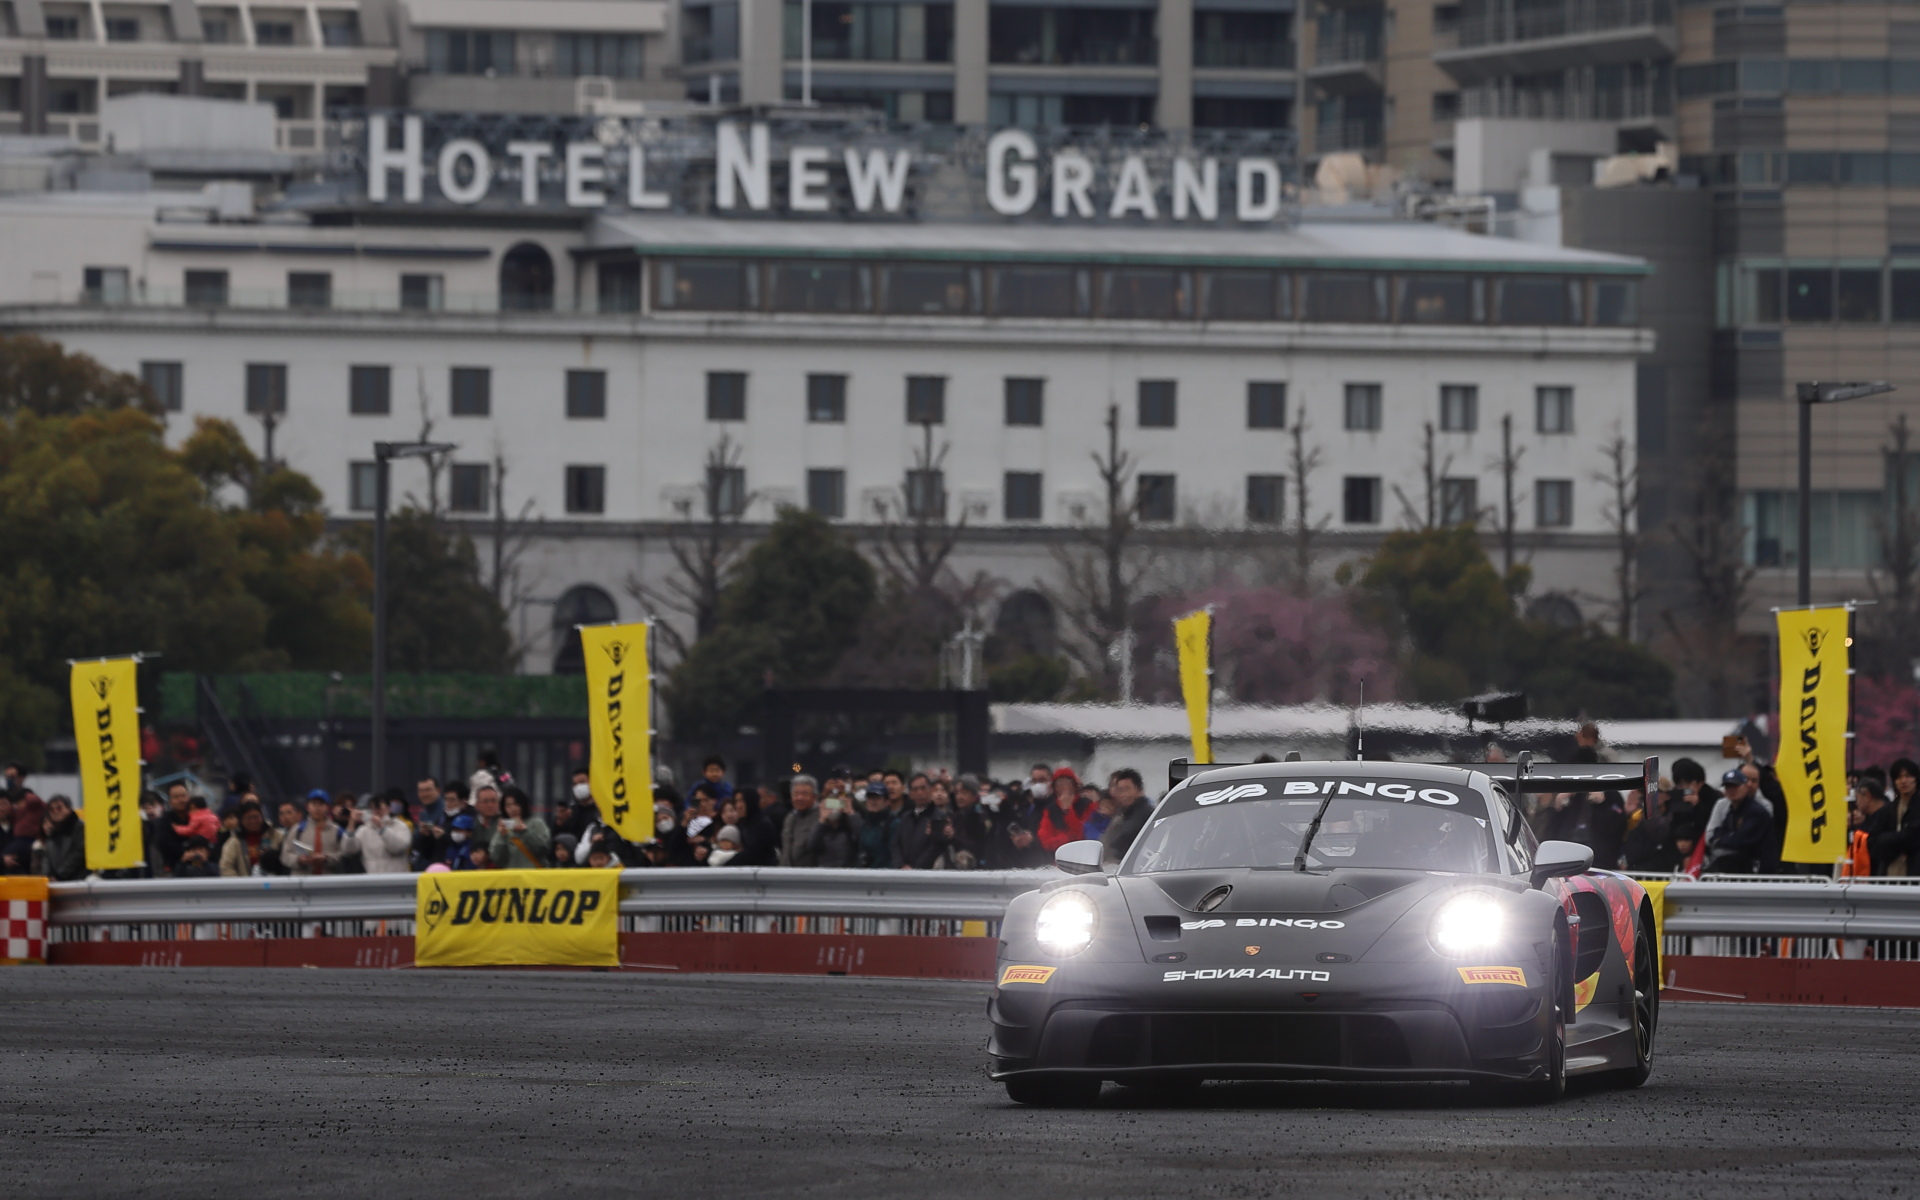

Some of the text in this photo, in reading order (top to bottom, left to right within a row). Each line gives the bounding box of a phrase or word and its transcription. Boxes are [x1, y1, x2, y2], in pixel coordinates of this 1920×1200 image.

[368, 115, 1281, 221] HOTEL NEW GRAND
[1283, 781, 1459, 805] BINGO
[451, 887, 601, 926] DUNLOP
[1235, 918, 1345, 930] BINGO
[1005, 968, 1049, 981] PIRELLI
[1163, 968, 1330, 982] SHOWA AUTO
[1465, 969, 1520, 982] PIRELLI
